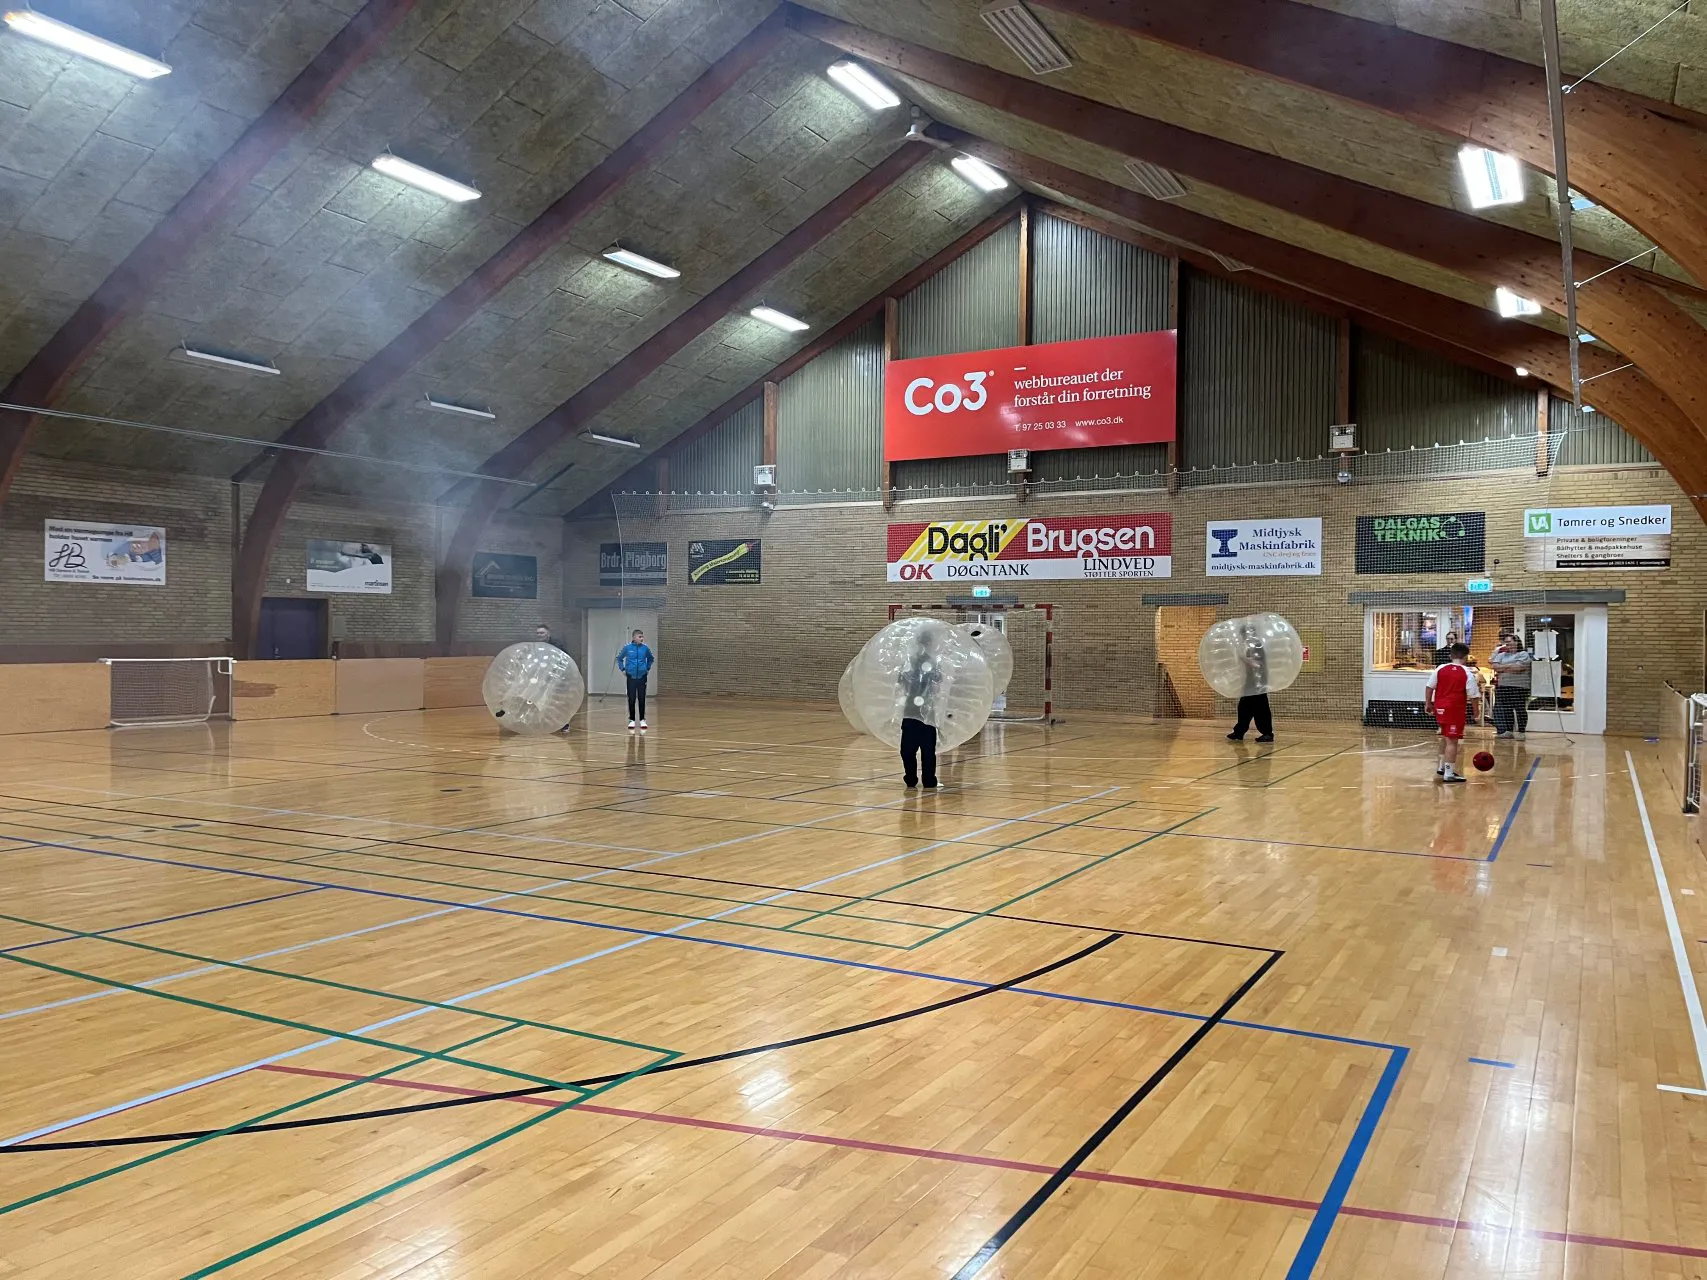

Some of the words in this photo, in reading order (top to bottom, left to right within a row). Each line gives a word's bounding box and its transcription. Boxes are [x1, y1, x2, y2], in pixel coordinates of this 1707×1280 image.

[1014, 371, 1099, 390] webbureauet
[1101, 368, 1124, 381] der
[1014, 392, 1056, 408] forstår
[1058, 390, 1080, 403] din
[1083, 384, 1151, 399] forretning
[1022, 423, 1032, 431] 97
[1045, 421, 1055, 430] 03
[1056, 420, 1067, 429] 33
[1075, 416, 1124, 427] www.co3.dk
[1374, 516, 1441, 530] DALGAS
[1557, 518, 1597, 527] Tømrer
[1600, 518, 1615, 528] og
[1618, 516, 1667, 526] Snedker
[1252, 527, 1302, 539] Midtjysk
[1374, 529, 1441, 541] TEKNIK
[1027, 522, 1155, 560] Brugsen
[1239, 540, 1316, 551] Maskinfabrik
[625, 551, 667, 571] Plagborg
[1083, 555, 1155, 571] LINDVED
[1211, 562, 1316, 572] midtjysk-maskinfabrik.dk
[900, 563, 935, 580] OK
[947, 563, 1030, 577] DØGNTANK
[1119, 570, 1154, 578] SPORTEN
